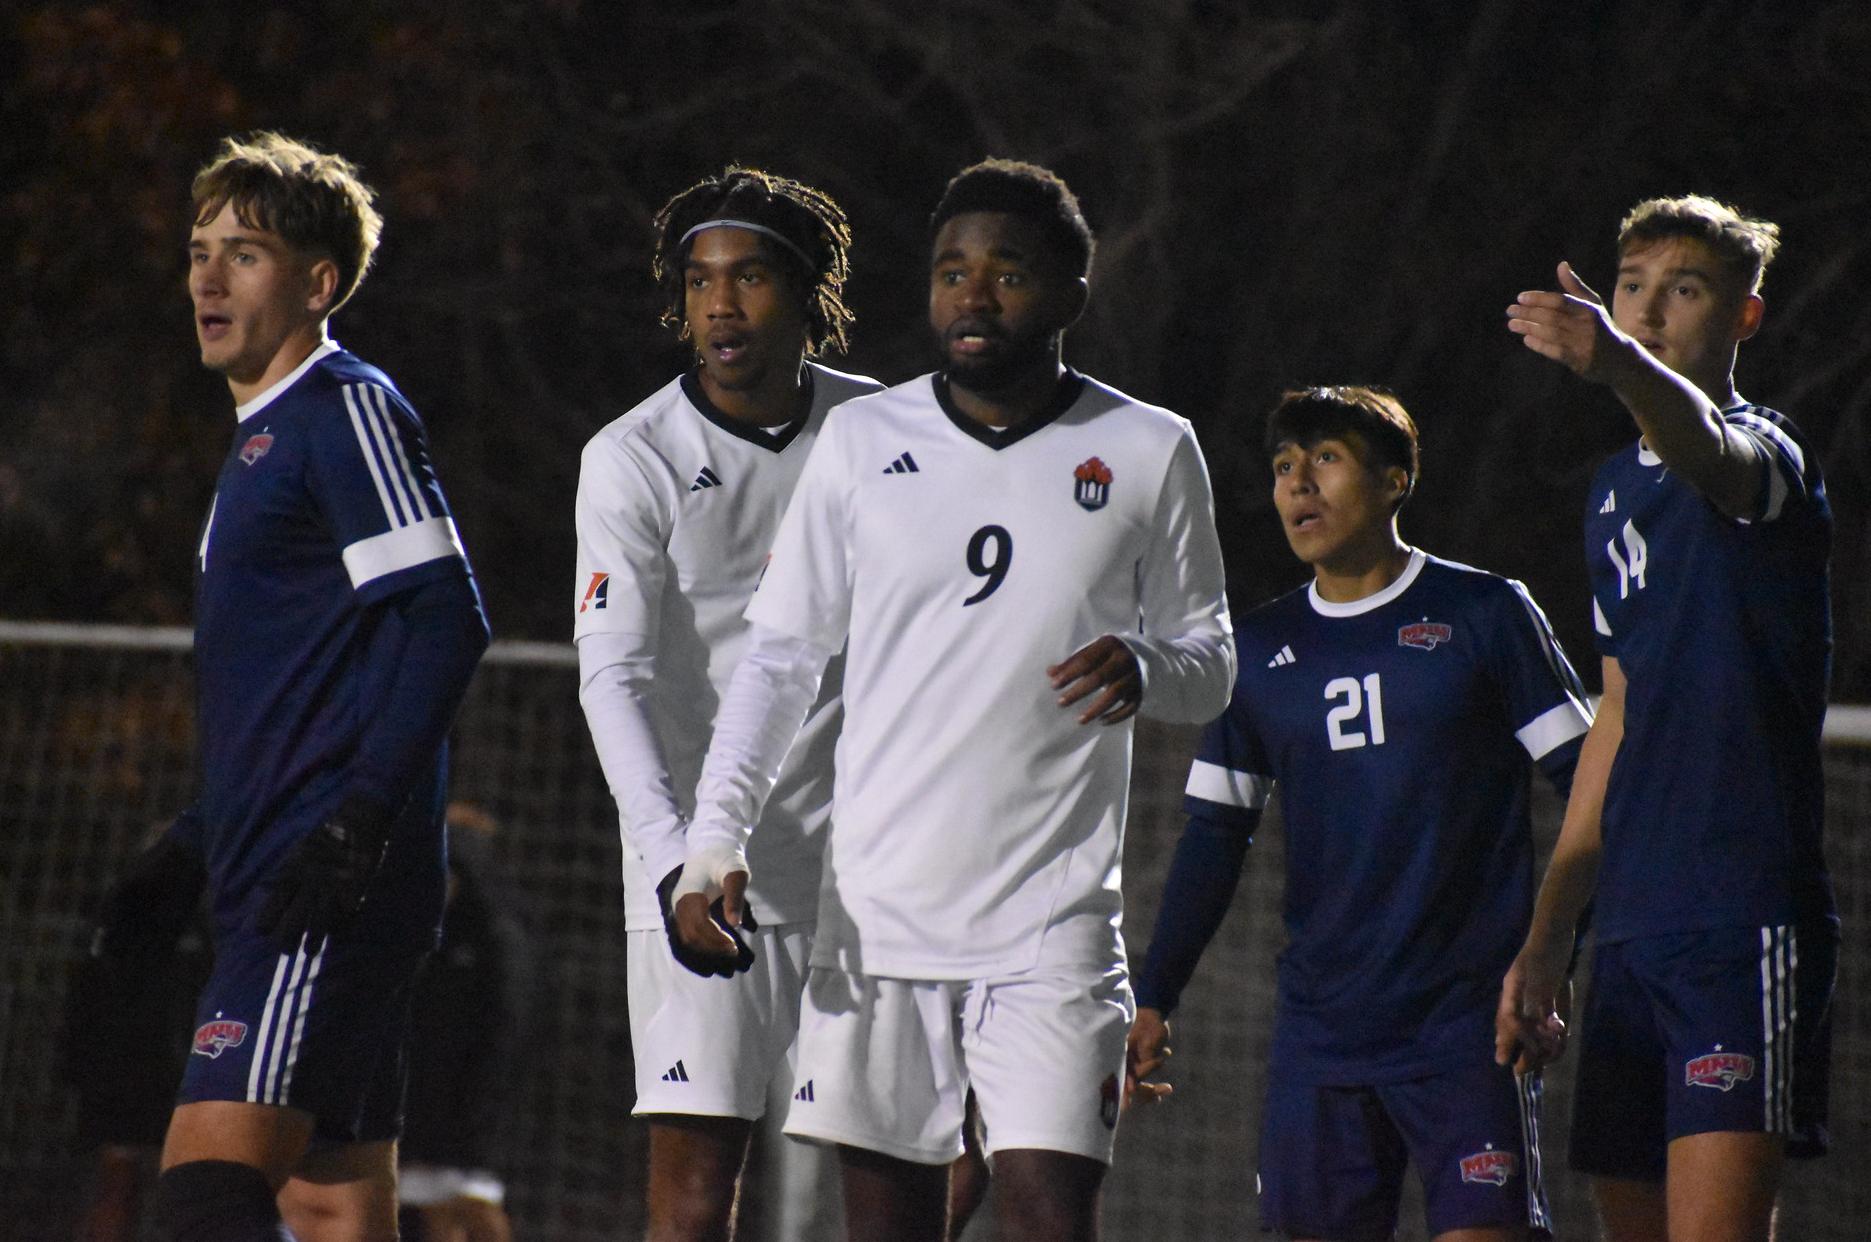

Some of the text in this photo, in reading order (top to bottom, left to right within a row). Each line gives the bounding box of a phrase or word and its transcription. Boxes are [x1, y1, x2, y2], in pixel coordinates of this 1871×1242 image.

[962, 524, 1013, 607] 9
[1607, 517, 1647, 600] 14
[1324, 672, 1385, 751] 21
